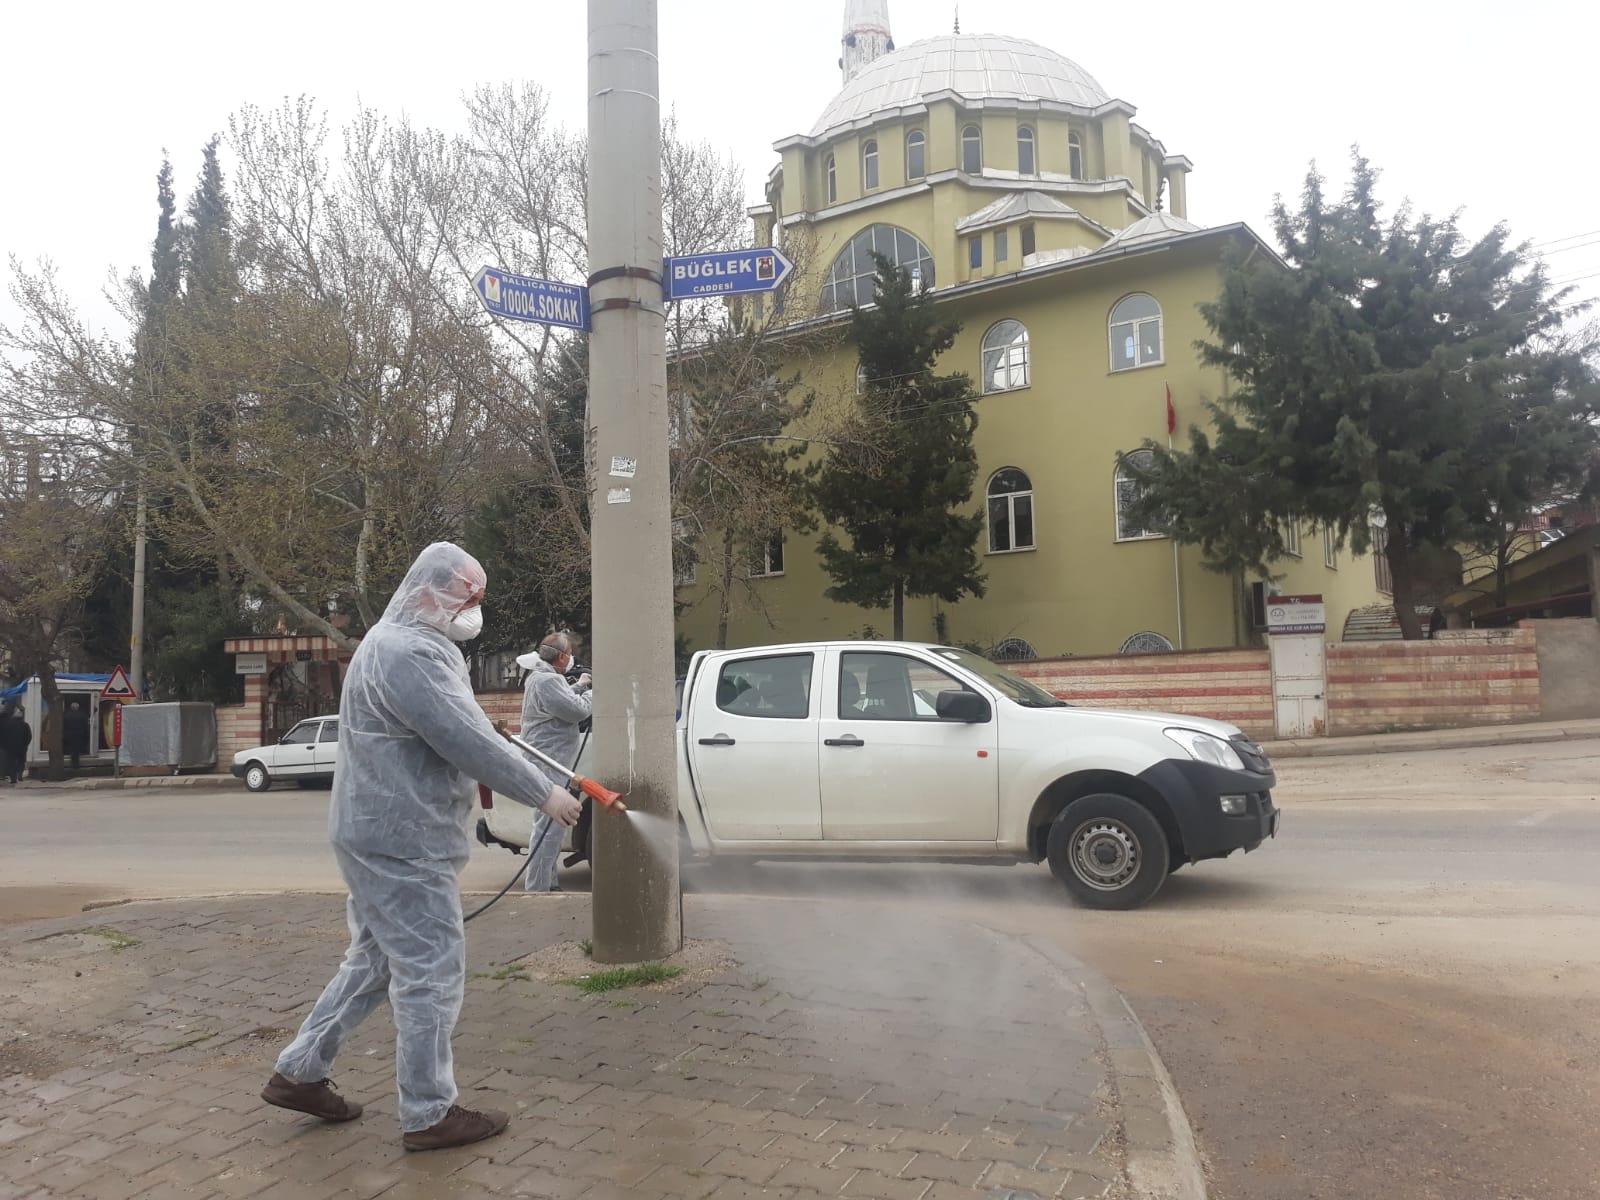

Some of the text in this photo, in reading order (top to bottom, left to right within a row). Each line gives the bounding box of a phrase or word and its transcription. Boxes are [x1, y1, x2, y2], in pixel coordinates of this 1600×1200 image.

[674, 259, 753, 280] BÜĞLEK
[502, 275, 576, 296] BALLICA MAH.
[693, 281, 733, 293] CADDESİ
